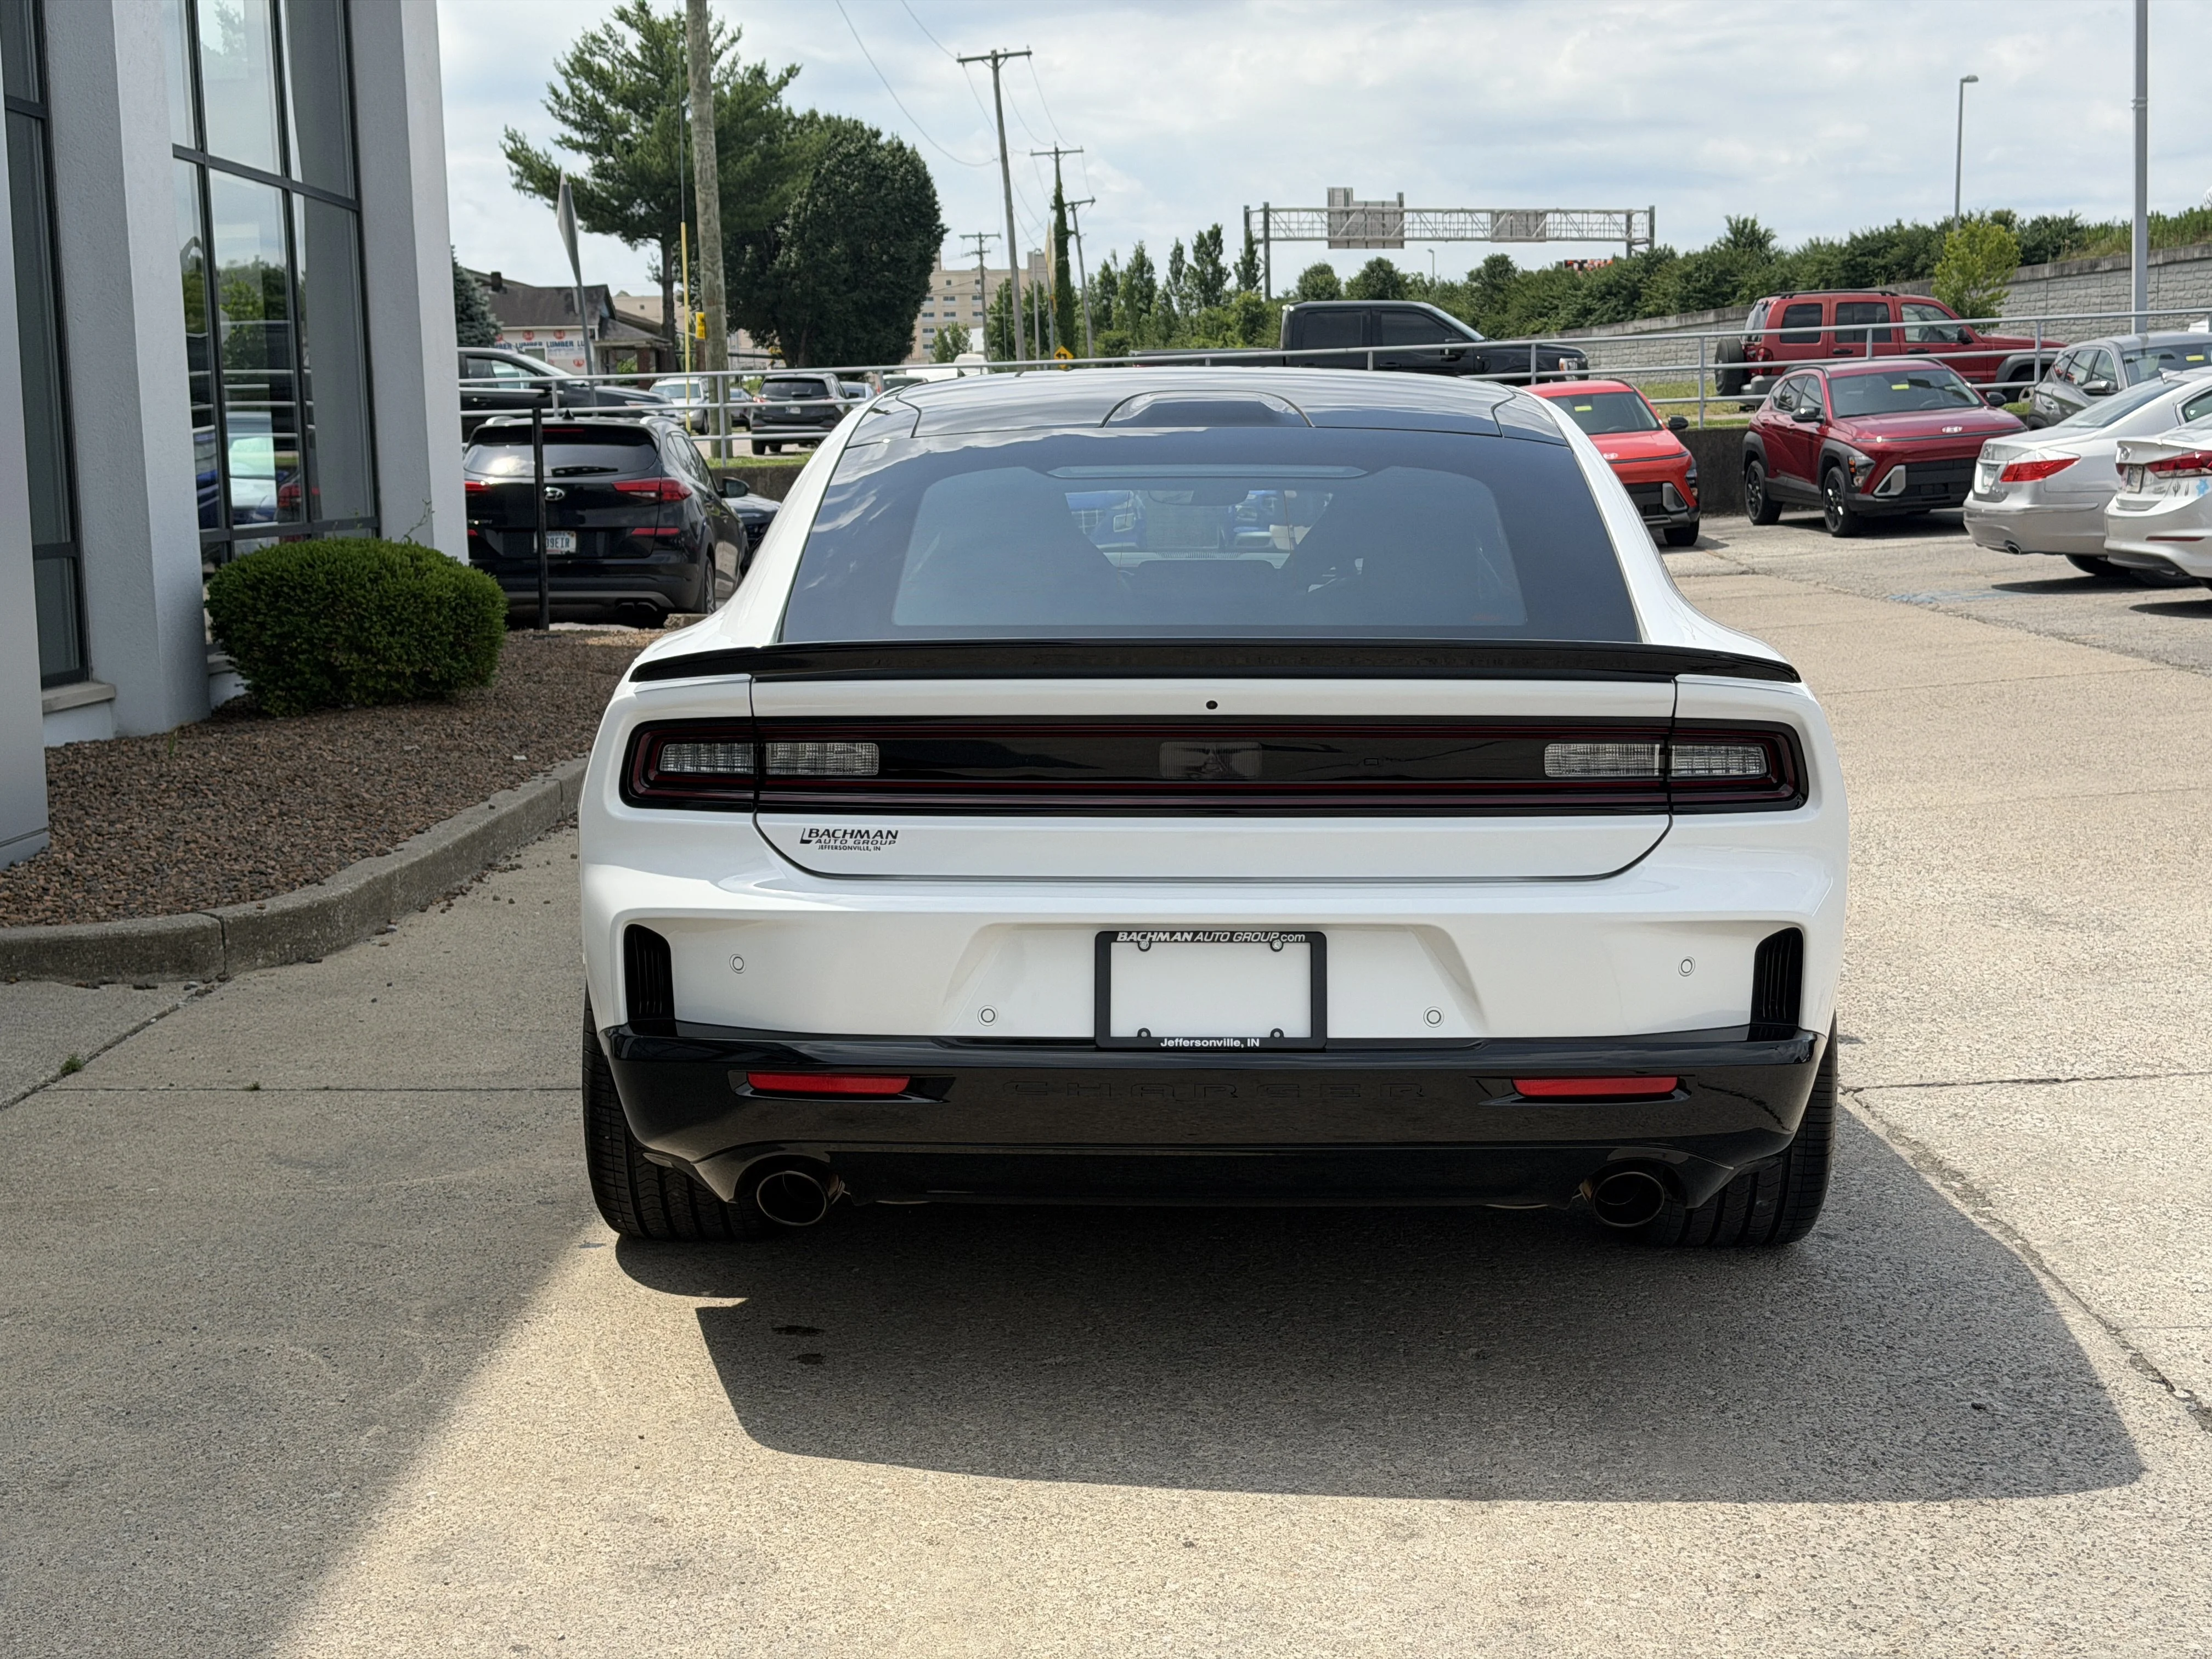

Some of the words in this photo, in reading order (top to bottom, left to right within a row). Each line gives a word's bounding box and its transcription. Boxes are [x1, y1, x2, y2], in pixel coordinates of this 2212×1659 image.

[808, 828, 899, 840] BACHMAN
[1116, 932, 1194, 942] BACHMAN
[1194, 932, 1231, 942] AUTO
[1160, 1038, 1244, 1048] Jeffersonville,
[1247, 1038, 1260, 1047] IN
[1002, 1081, 1425, 1098] CHARGER
